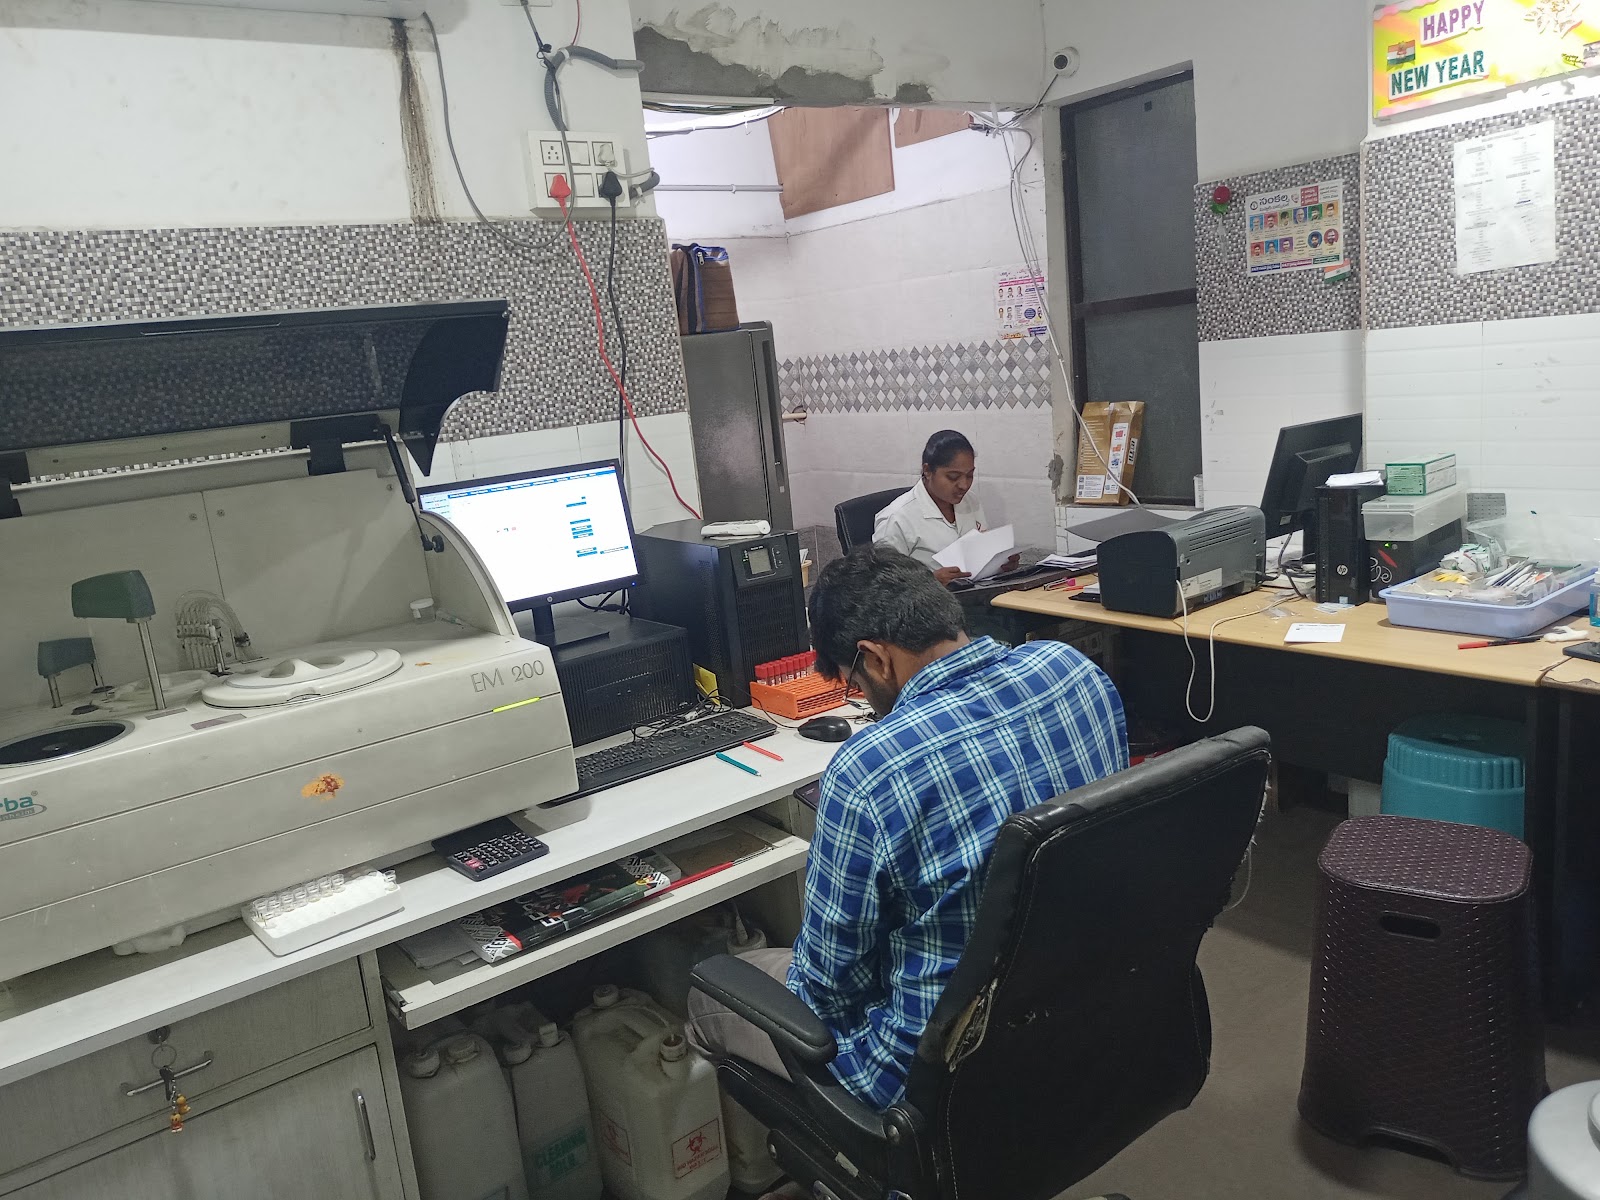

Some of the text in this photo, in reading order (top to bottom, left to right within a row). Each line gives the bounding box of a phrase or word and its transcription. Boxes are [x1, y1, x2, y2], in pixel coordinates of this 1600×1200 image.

[1423, 0, 1484, 41] HAPPY
[1391, 50, 1485, 96] NEW YEAR
[1337, 565, 1348, 575] hp
[471, 660, 545, 692] EM 200
[0, 797, 33, 812] ba
